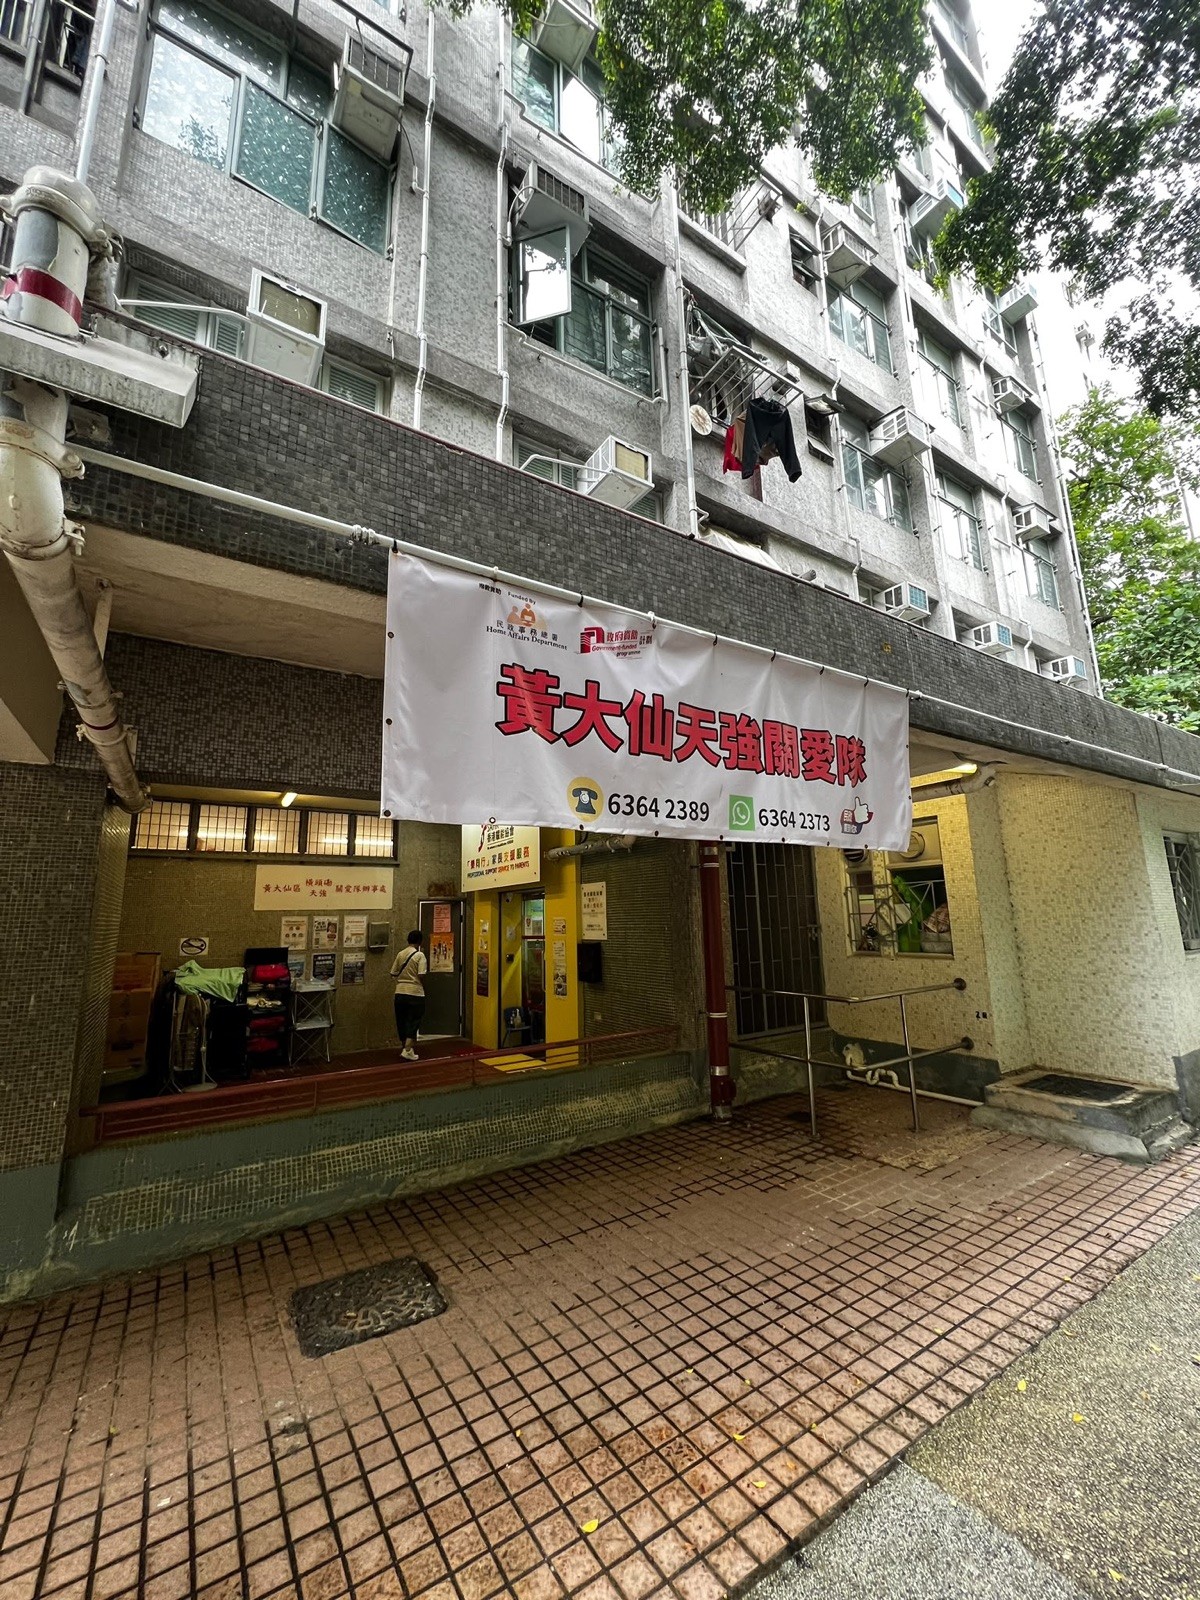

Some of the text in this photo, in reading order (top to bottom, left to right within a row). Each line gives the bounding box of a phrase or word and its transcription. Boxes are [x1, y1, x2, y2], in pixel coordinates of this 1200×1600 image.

[486, 625, 568, 651] Home Affairs Department
[496, 619, 558, 642] 民政事務總署
[607, 629, 638, 642] 政府資助
[592, 643, 638, 652] Government-funded
[495, 662, 868, 788] 黃大仙天強關愛隊
[608, 793, 710, 822] 6364 2389
[758, 808, 797, 829] 6364
[800, 812, 831, 832] 2373
[263, 883, 300, 893] 黃大仙區
